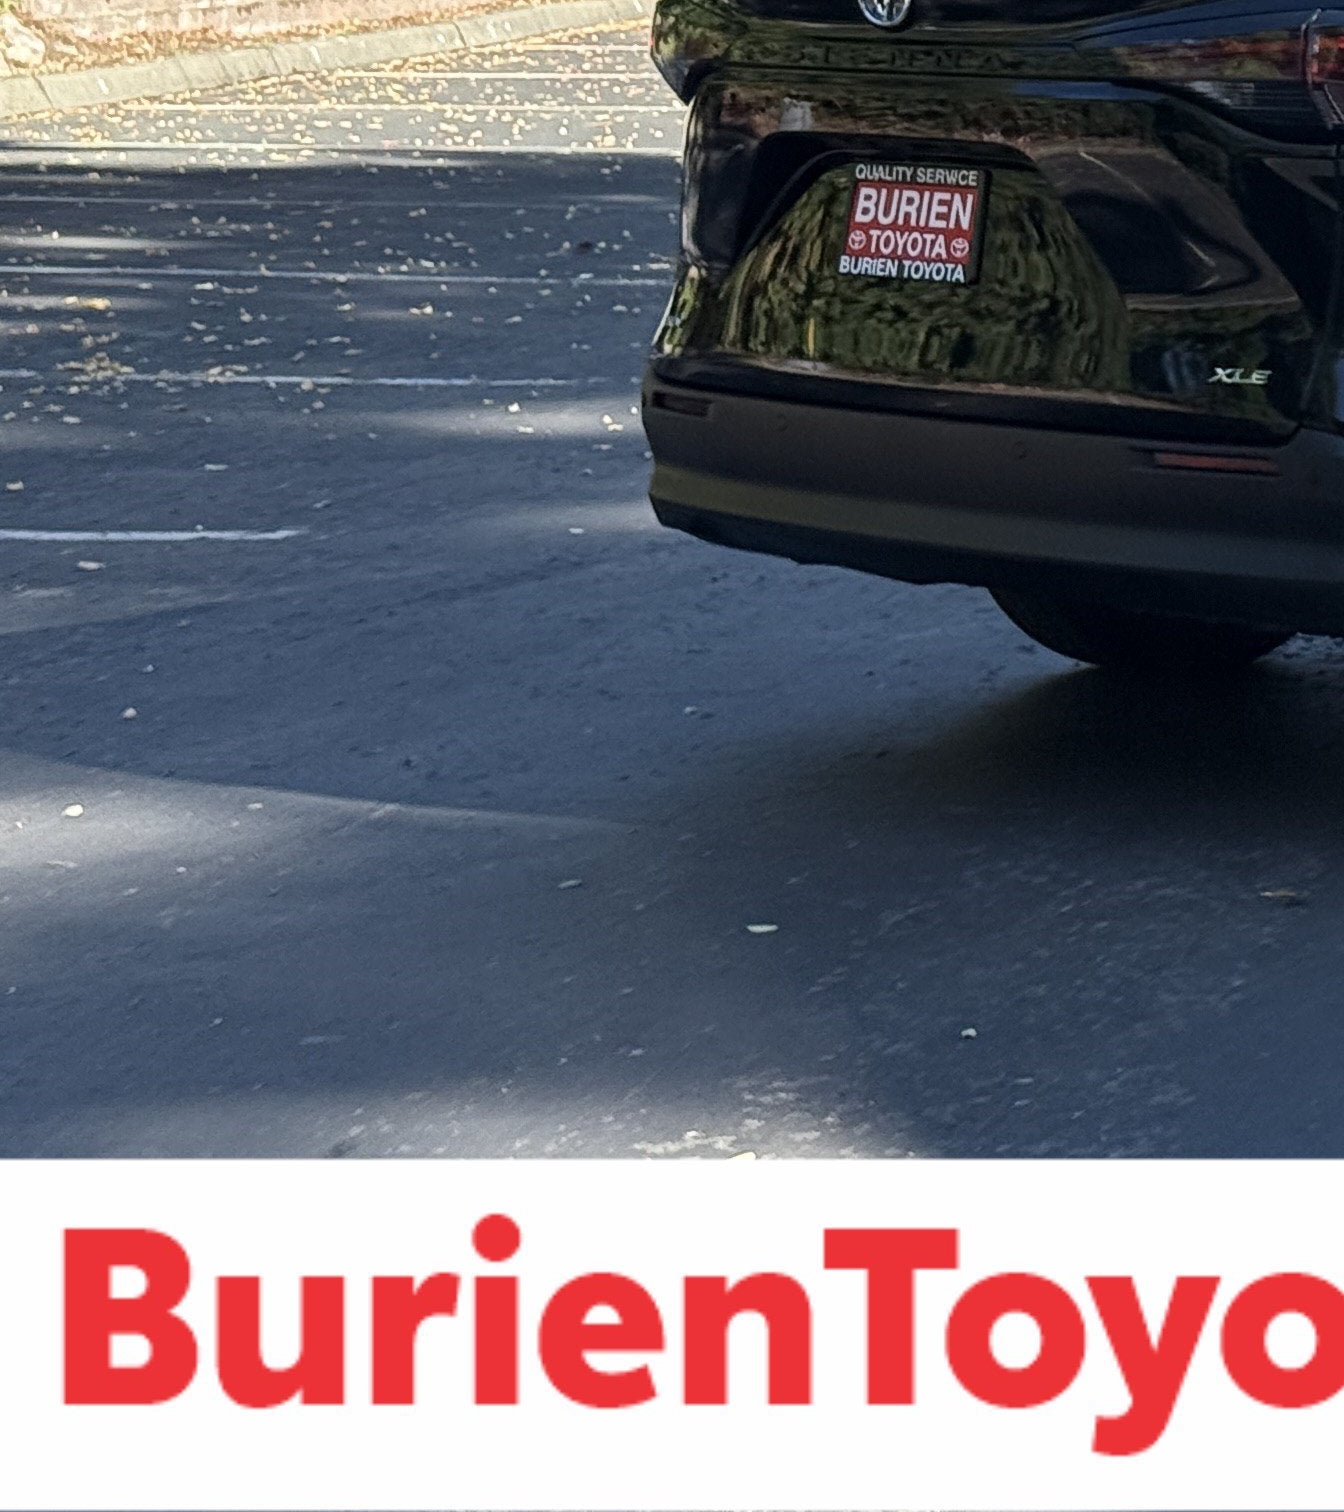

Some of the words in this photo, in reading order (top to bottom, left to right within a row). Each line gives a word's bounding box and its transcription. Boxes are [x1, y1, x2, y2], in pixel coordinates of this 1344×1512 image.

[855, 163, 914, 182] QUALITY
[916, 167, 979, 186] SERVICE
[854, 186, 974, 231] BURIEN
[868, 229, 948, 259] TOYOTA
[838, 255, 899, 278] BURIEN
[902, 259, 966, 283] TOYOTA
[1206, 367, 1273, 385] XLE
